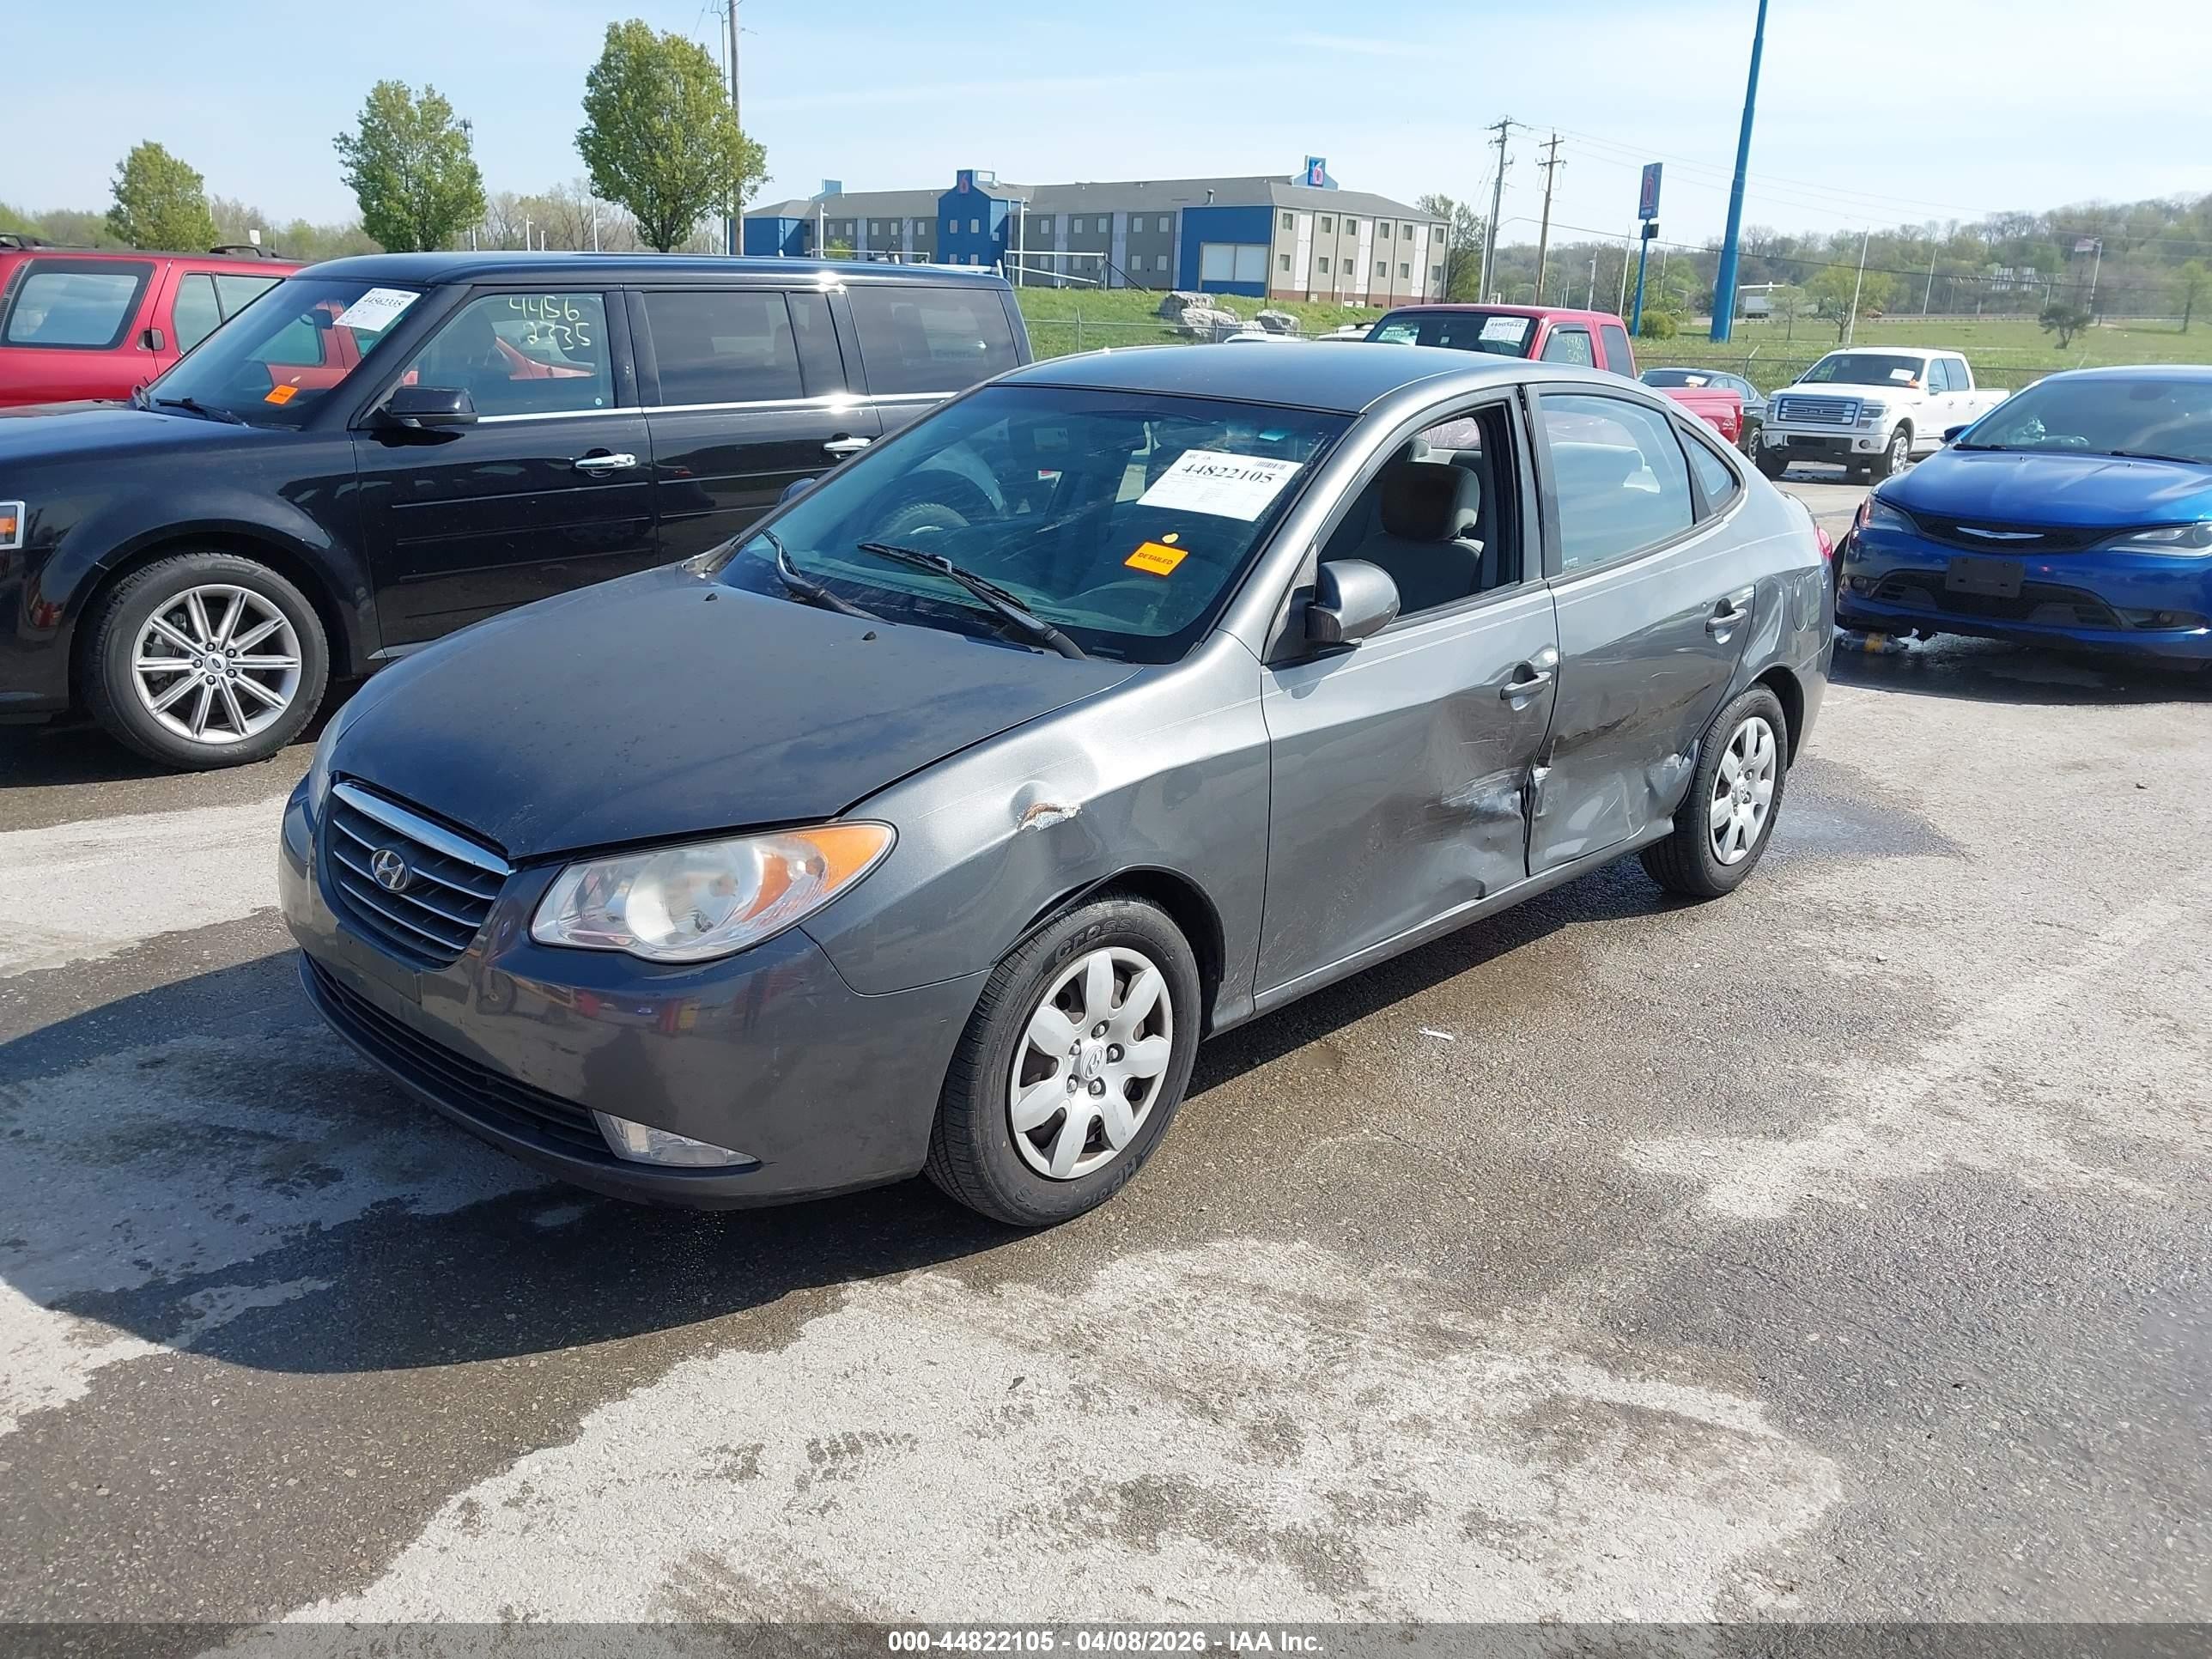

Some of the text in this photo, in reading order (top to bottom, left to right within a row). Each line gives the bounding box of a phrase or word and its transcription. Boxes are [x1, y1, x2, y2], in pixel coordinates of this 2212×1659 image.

[1312, 161, 1323, 185] 6
[508, 295, 580, 321] 4456
[525, 320, 591, 350] 2335
[1182, 463, 1277, 483] 44822105
[1137, 552, 1174, 565] DETAILED
